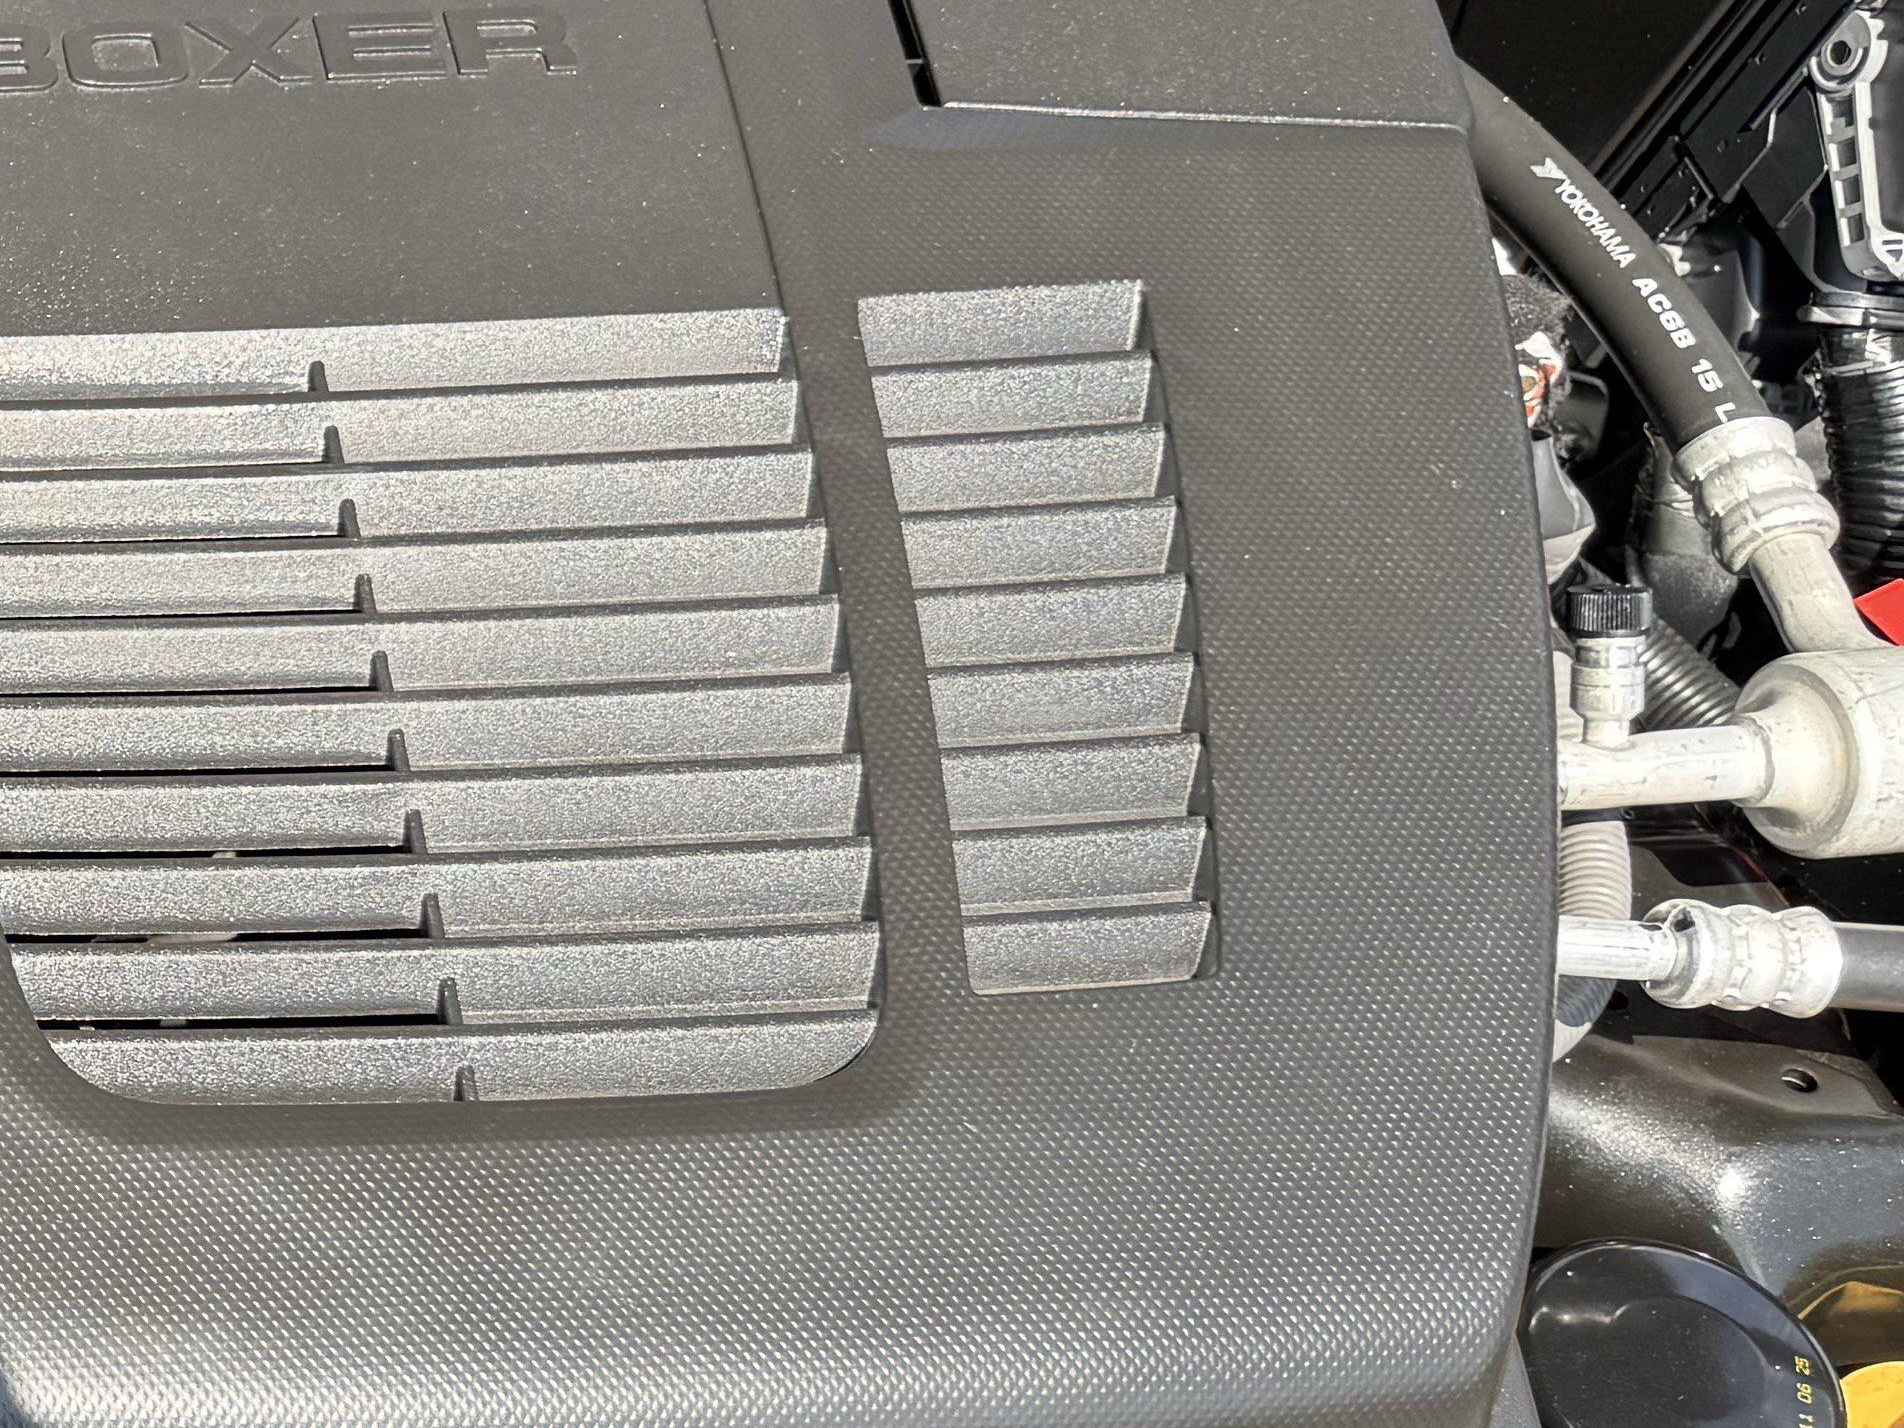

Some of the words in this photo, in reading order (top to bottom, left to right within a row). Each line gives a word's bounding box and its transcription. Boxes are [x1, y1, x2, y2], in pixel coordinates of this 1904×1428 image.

[1555, 178, 1636, 269] YOKOHAMA
[1691, 358, 1724, 392] 15
[1794, 1355, 1811, 1376] 25
[1797, 1382, 1812, 1404] 06
